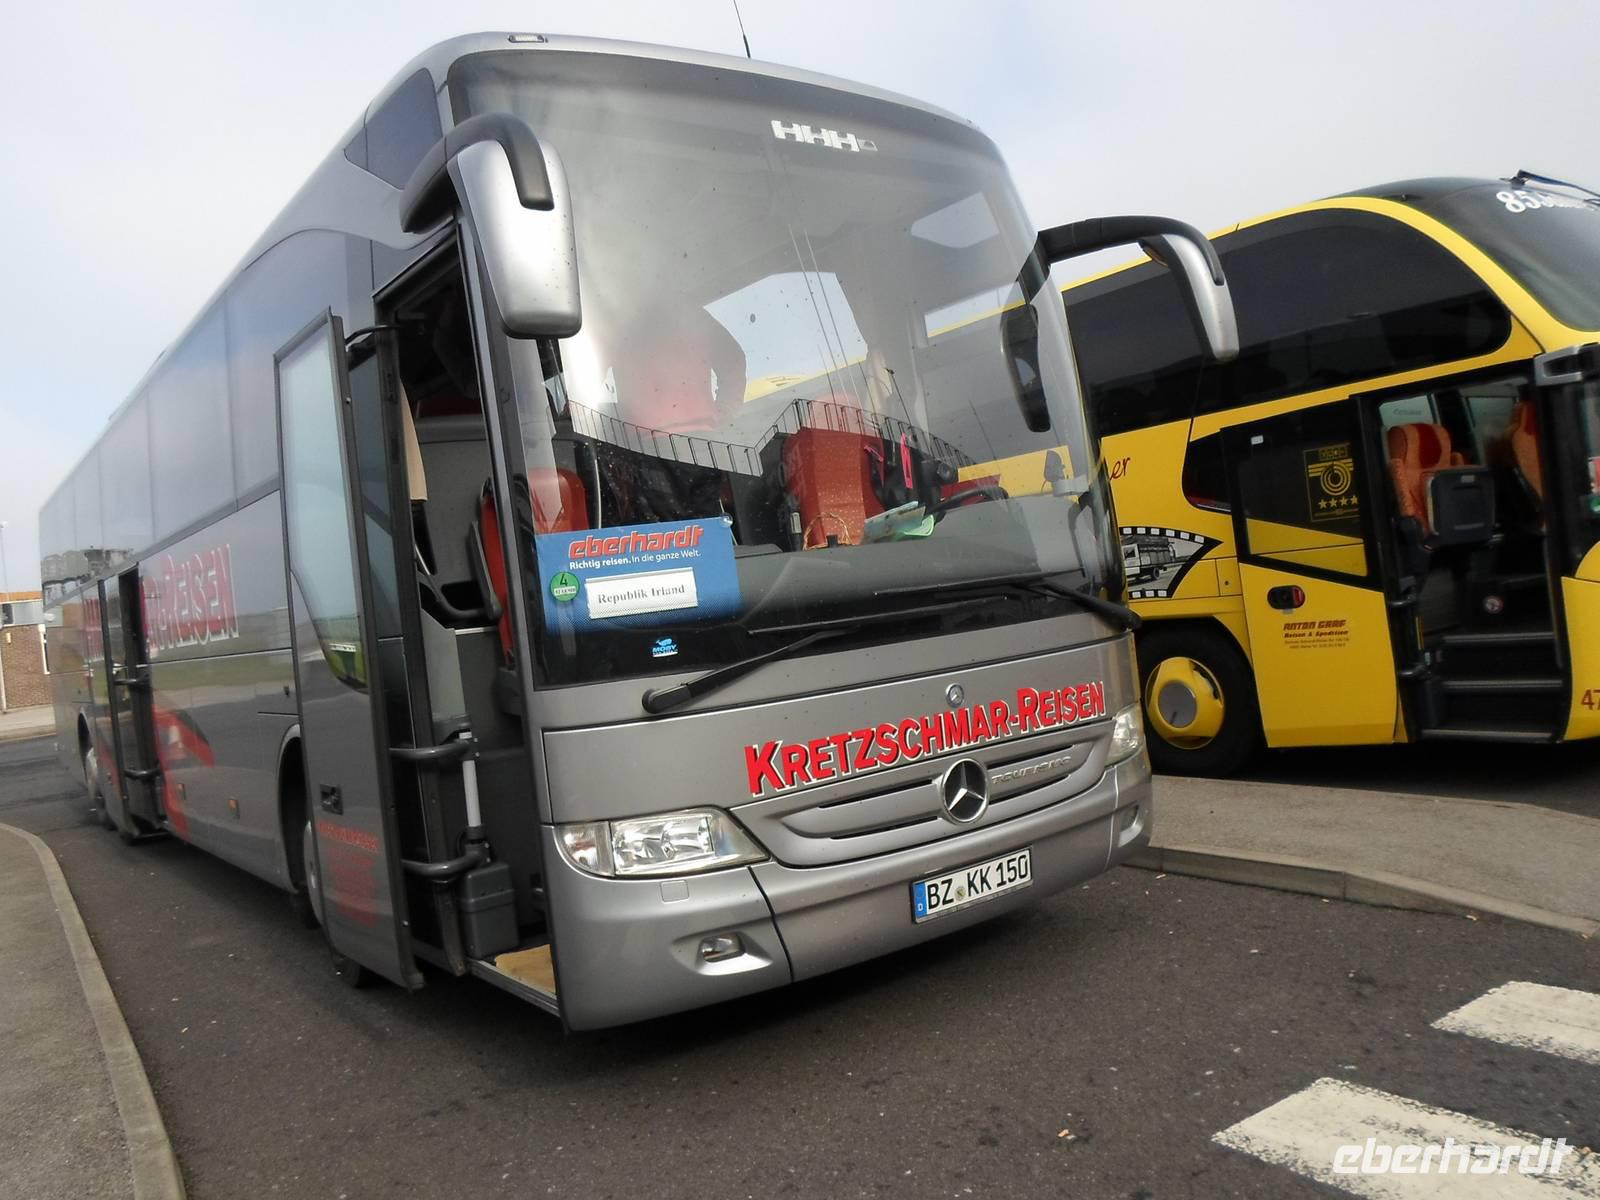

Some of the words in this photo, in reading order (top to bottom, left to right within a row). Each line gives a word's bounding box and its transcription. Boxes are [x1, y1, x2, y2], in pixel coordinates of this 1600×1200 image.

[568, 525, 704, 559] eberhardt
[569, 559, 601, 571] Richtig
[602, 556, 631, 567] reisen.
[632, 556, 640, 564] In
[641, 553, 654, 563] die
[656, 551, 679, 563] ganze
[680, 548, 701, 558] Welt.
[560, 573, 568, 586] 4
[598, 588, 648, 604] Republik
[651, 584, 685, 597] Irland
[744, 681, 1105, 798] KRETZSCHMAR-REISEN
[927, 878, 954, 910] BZ
[966, 866, 992, 897] KK
[996, 854, 1028, 888] 150
[917, 903, 924, 912] D
